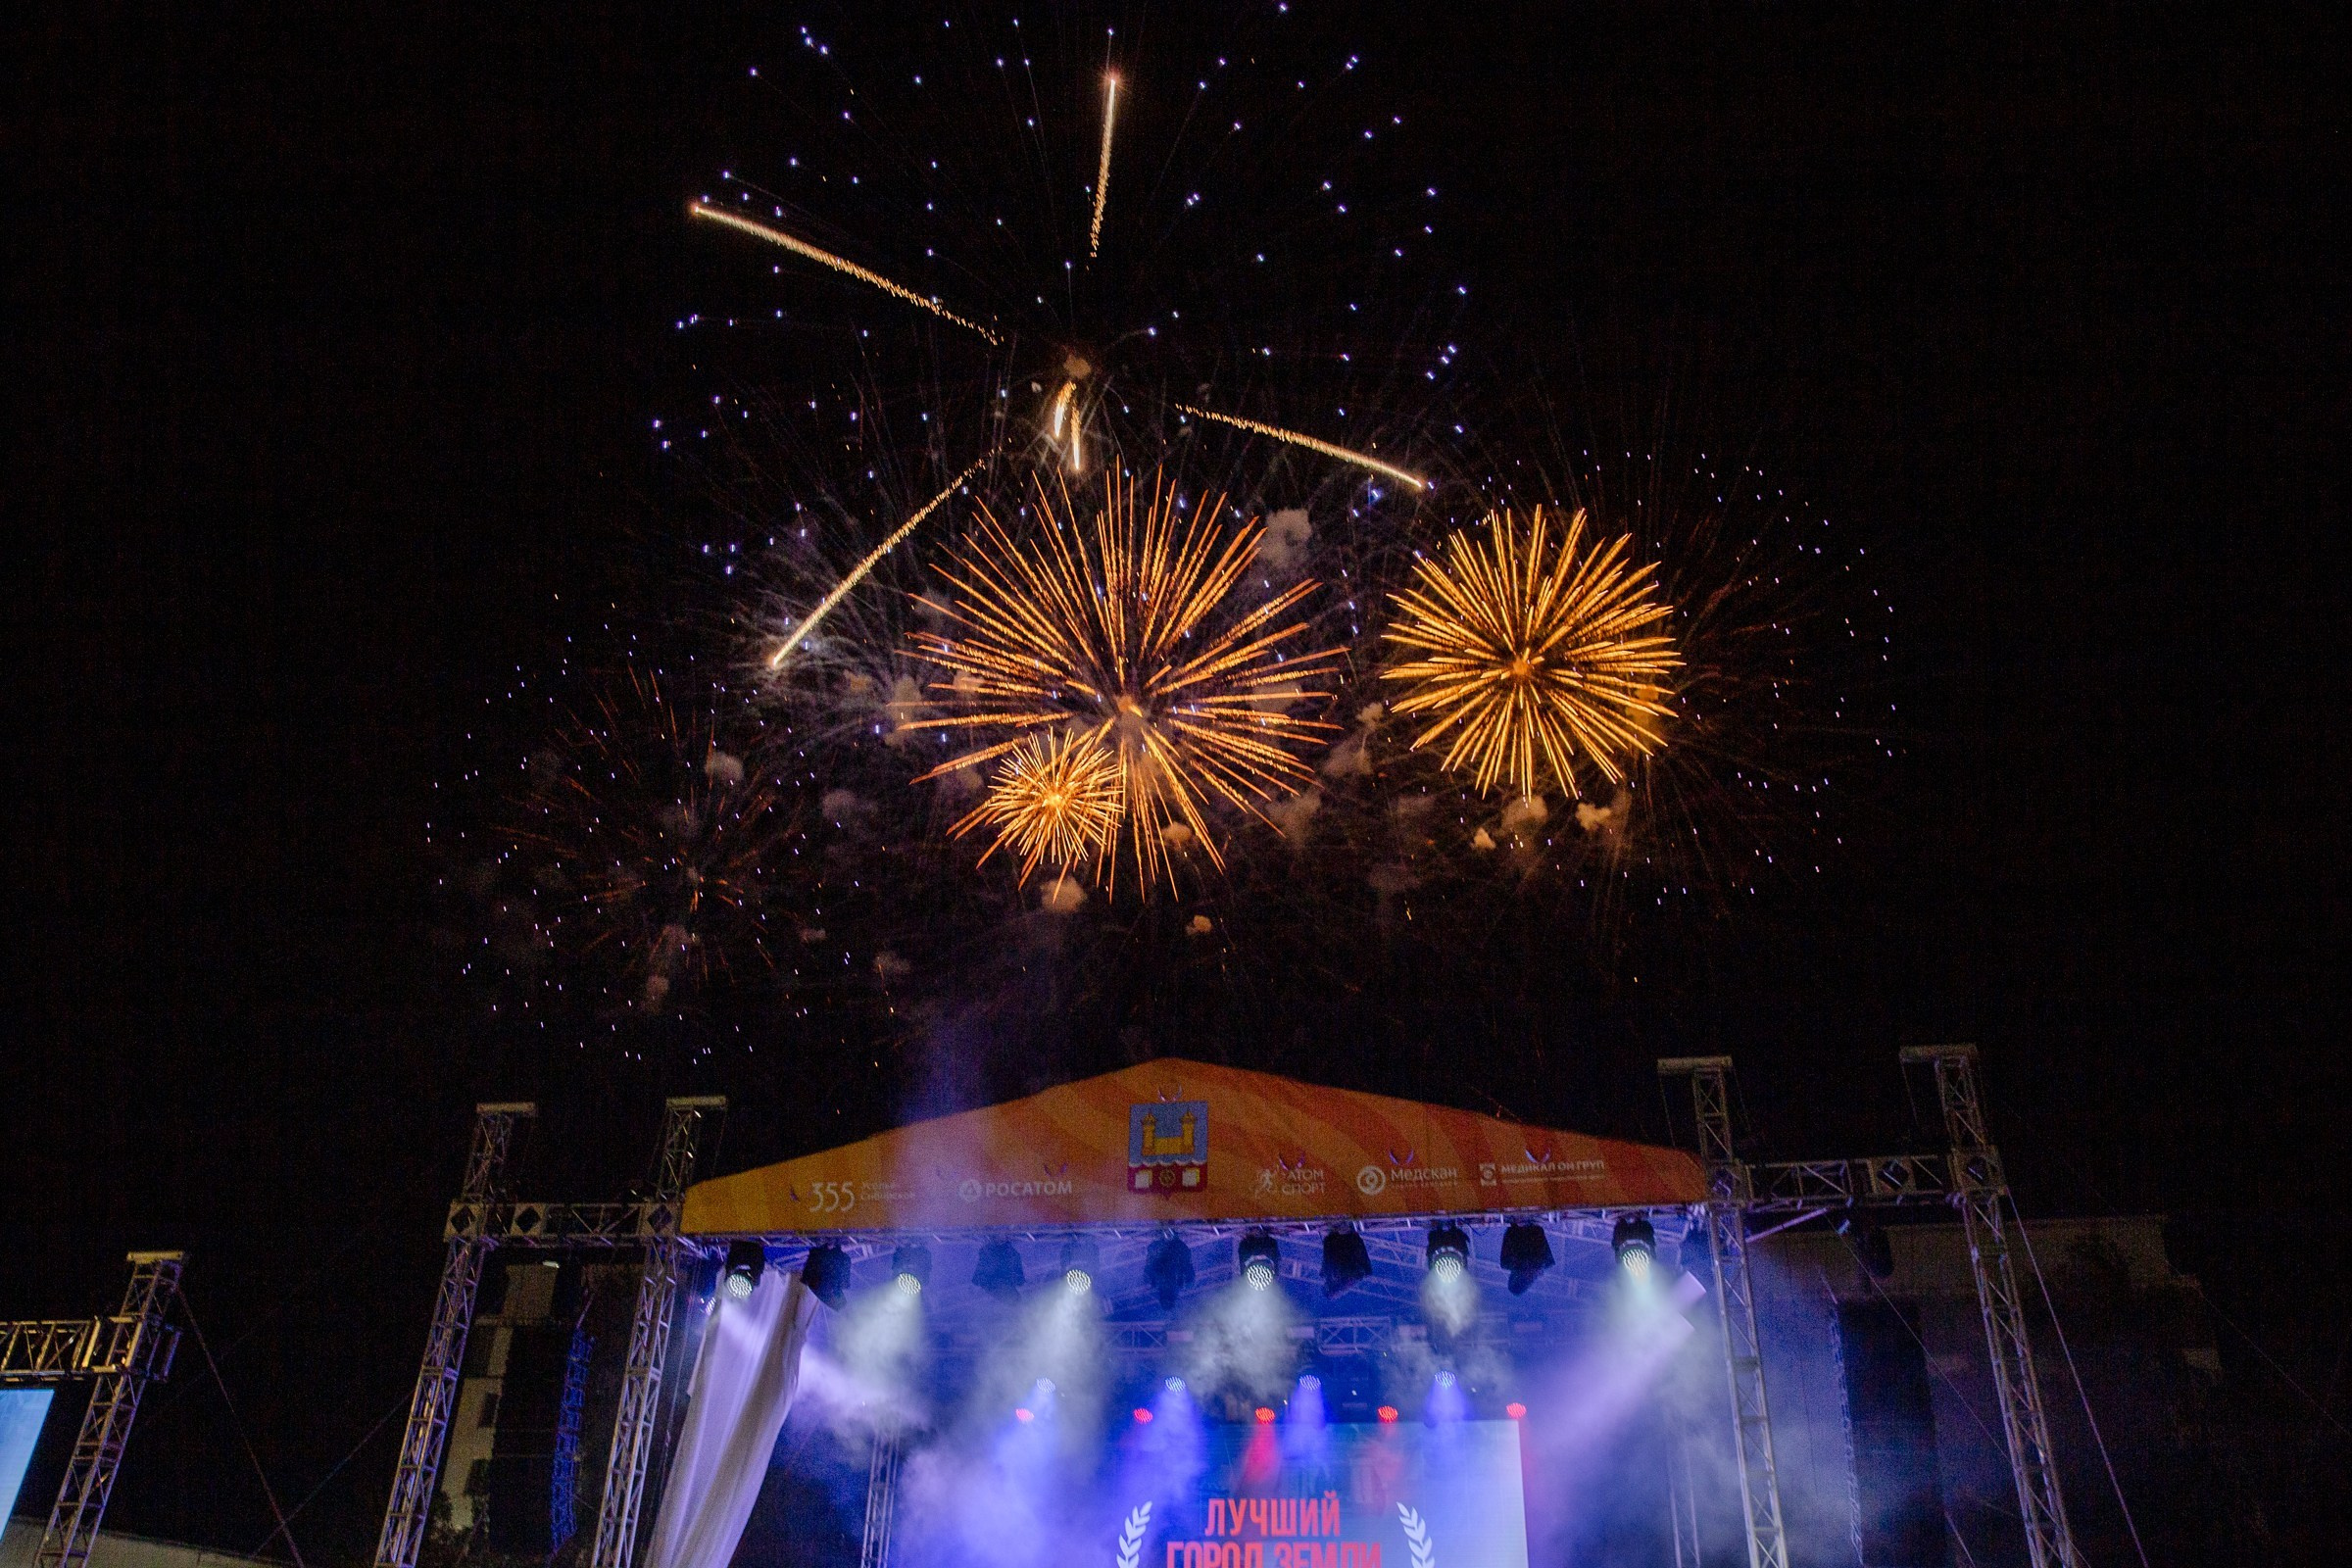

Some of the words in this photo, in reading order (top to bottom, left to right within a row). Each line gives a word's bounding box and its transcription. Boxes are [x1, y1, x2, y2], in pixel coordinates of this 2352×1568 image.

[1576, 1159, 1605, 1170] ГРУП
[1288, 1169, 1324, 1181] АТОМ
[1391, 1167, 1457, 1182] Медскан
[986, 1180, 1073, 1198] РОСАТОМ
[1281, 1181, 1325, 1195] СПОРТ
[809, 1182, 856, 1212] 355
[1204, 1490, 1341, 1537] ЛУЧШИЙ
[1166, 1541, 1263, 1568] ГОРОД
[1274, 1541, 1381, 1568] ЗЕМЛИ
